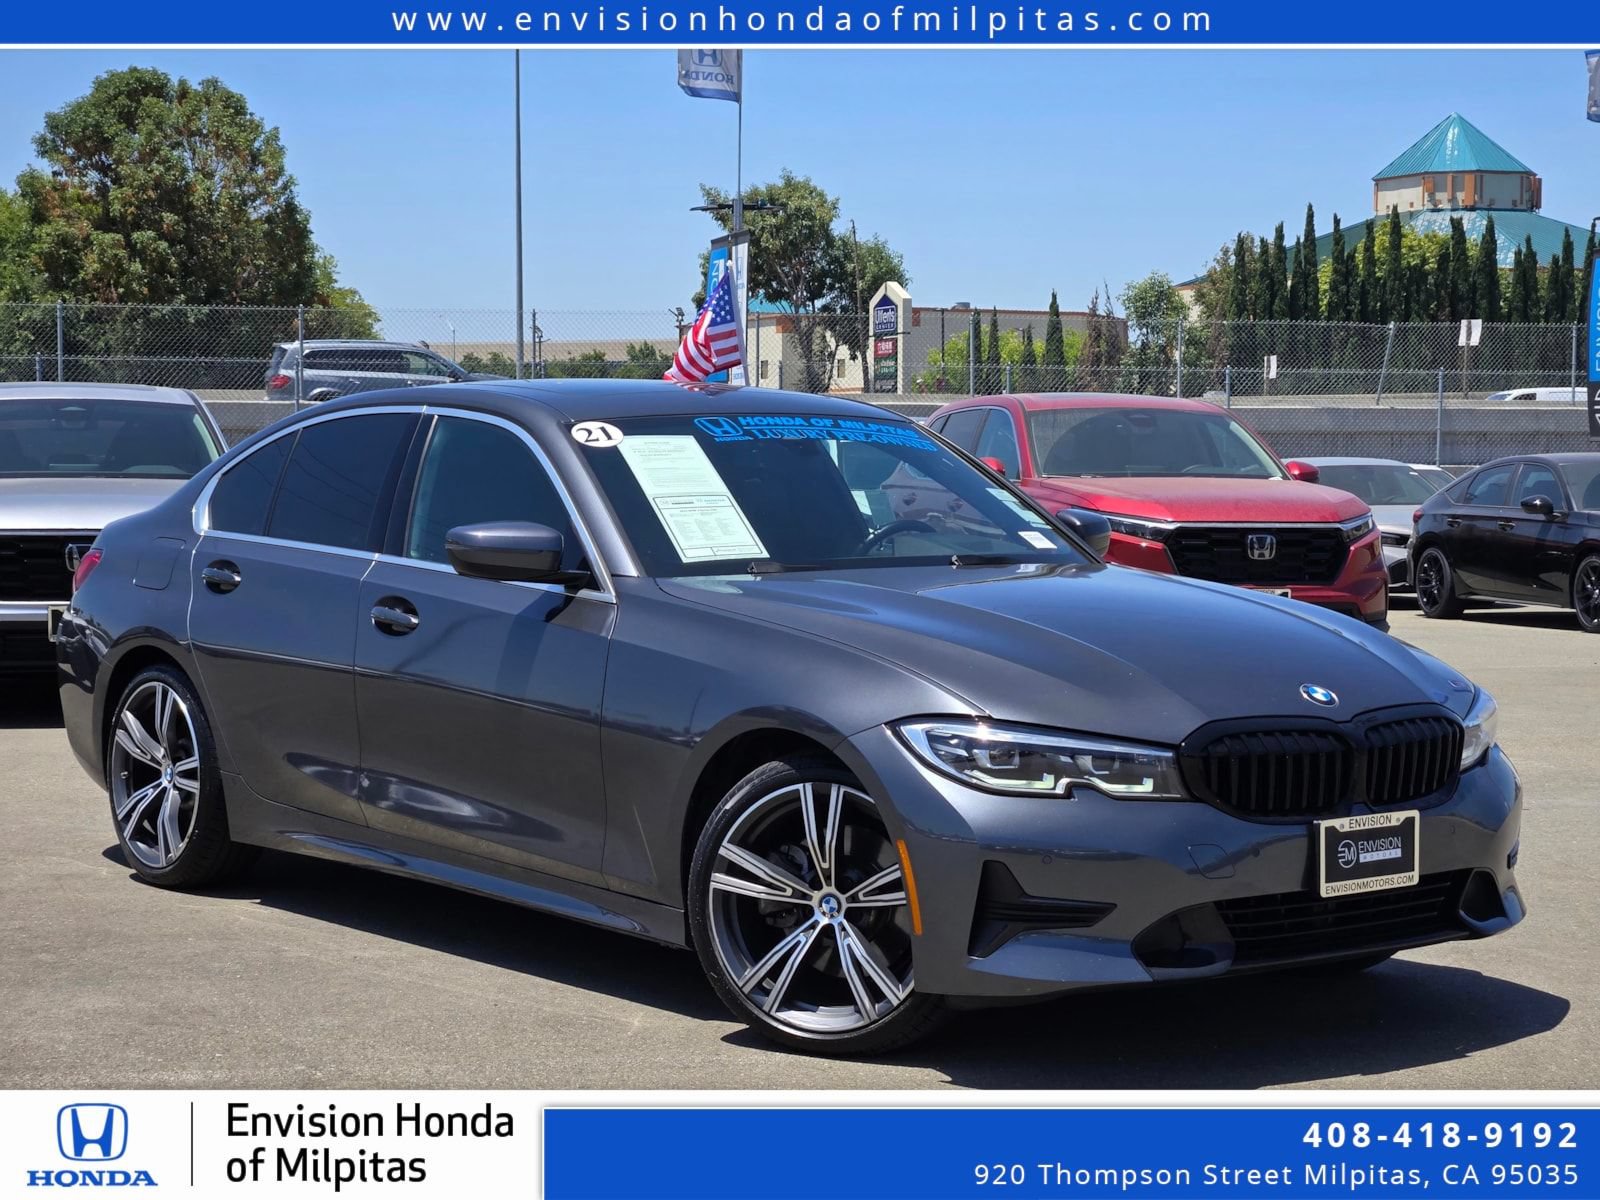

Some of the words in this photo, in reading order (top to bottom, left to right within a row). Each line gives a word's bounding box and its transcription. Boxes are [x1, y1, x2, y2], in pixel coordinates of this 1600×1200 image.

[575, 426, 618, 443] 21
[738, 416, 809, 427] HONDA
[810, 417, 835, 428] OF
[838, 419, 920, 439] MILPITAS
[755, 428, 832, 440] LUXURY
[1348, 814, 1392, 829] ENVISION
[1358, 836, 1402, 853] ENVISION
[1325, 874, 1415, 895] ENVISIONMOTORS.COM
